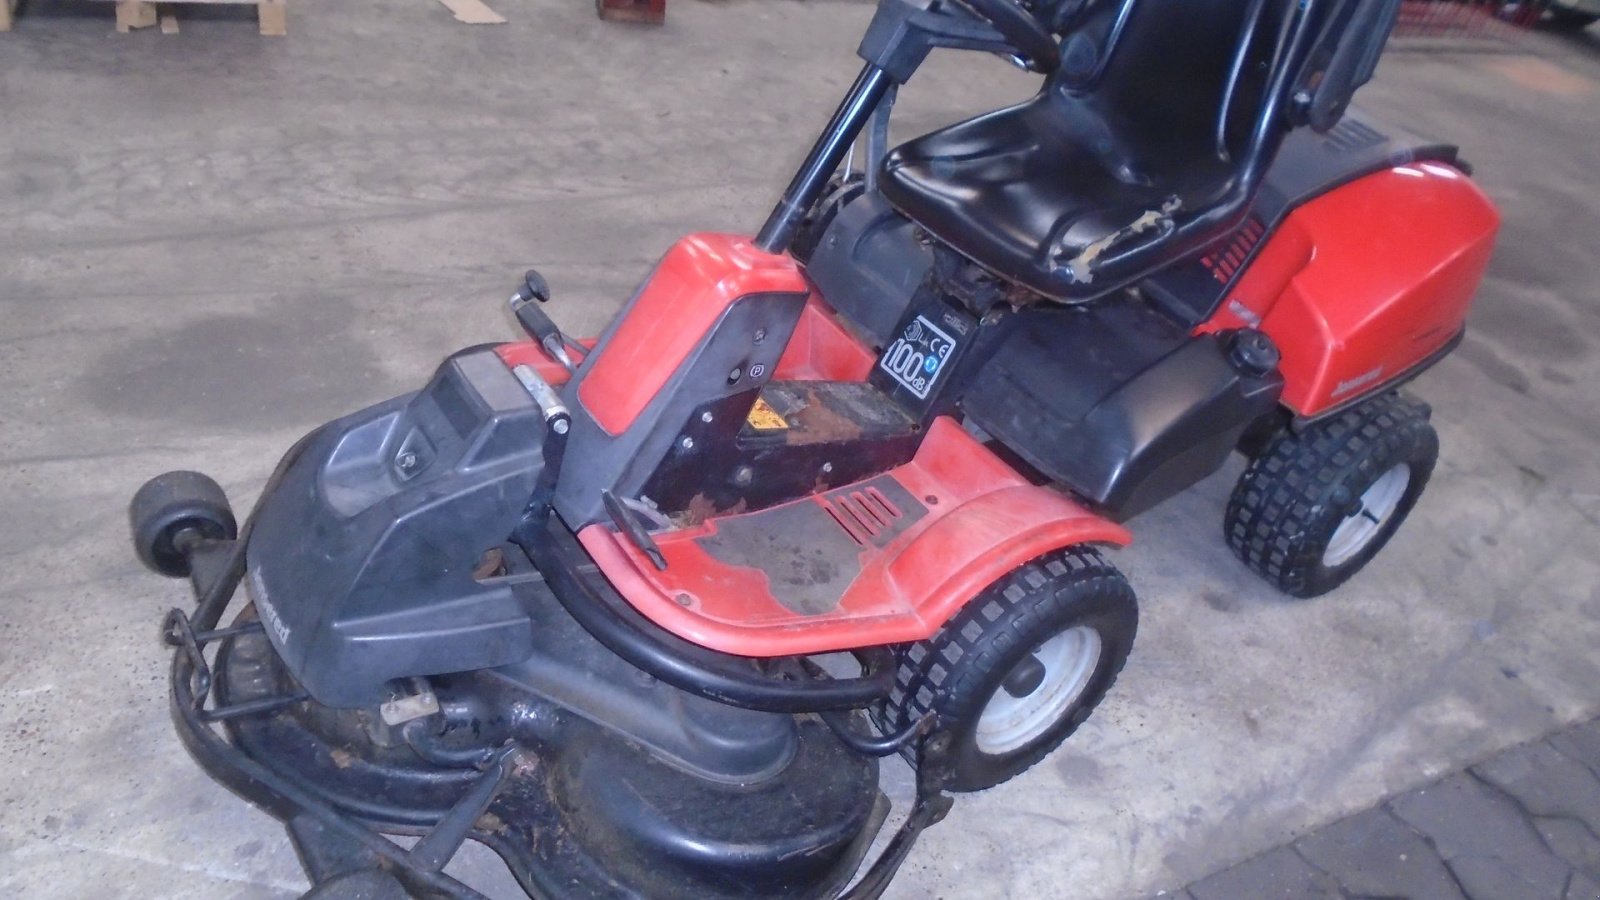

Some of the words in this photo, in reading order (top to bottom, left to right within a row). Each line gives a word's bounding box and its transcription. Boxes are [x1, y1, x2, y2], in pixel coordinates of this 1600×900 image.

[887, 338, 924, 382] 100
[912, 376, 925, 390] dB
[930, 337, 949, 358] CE
